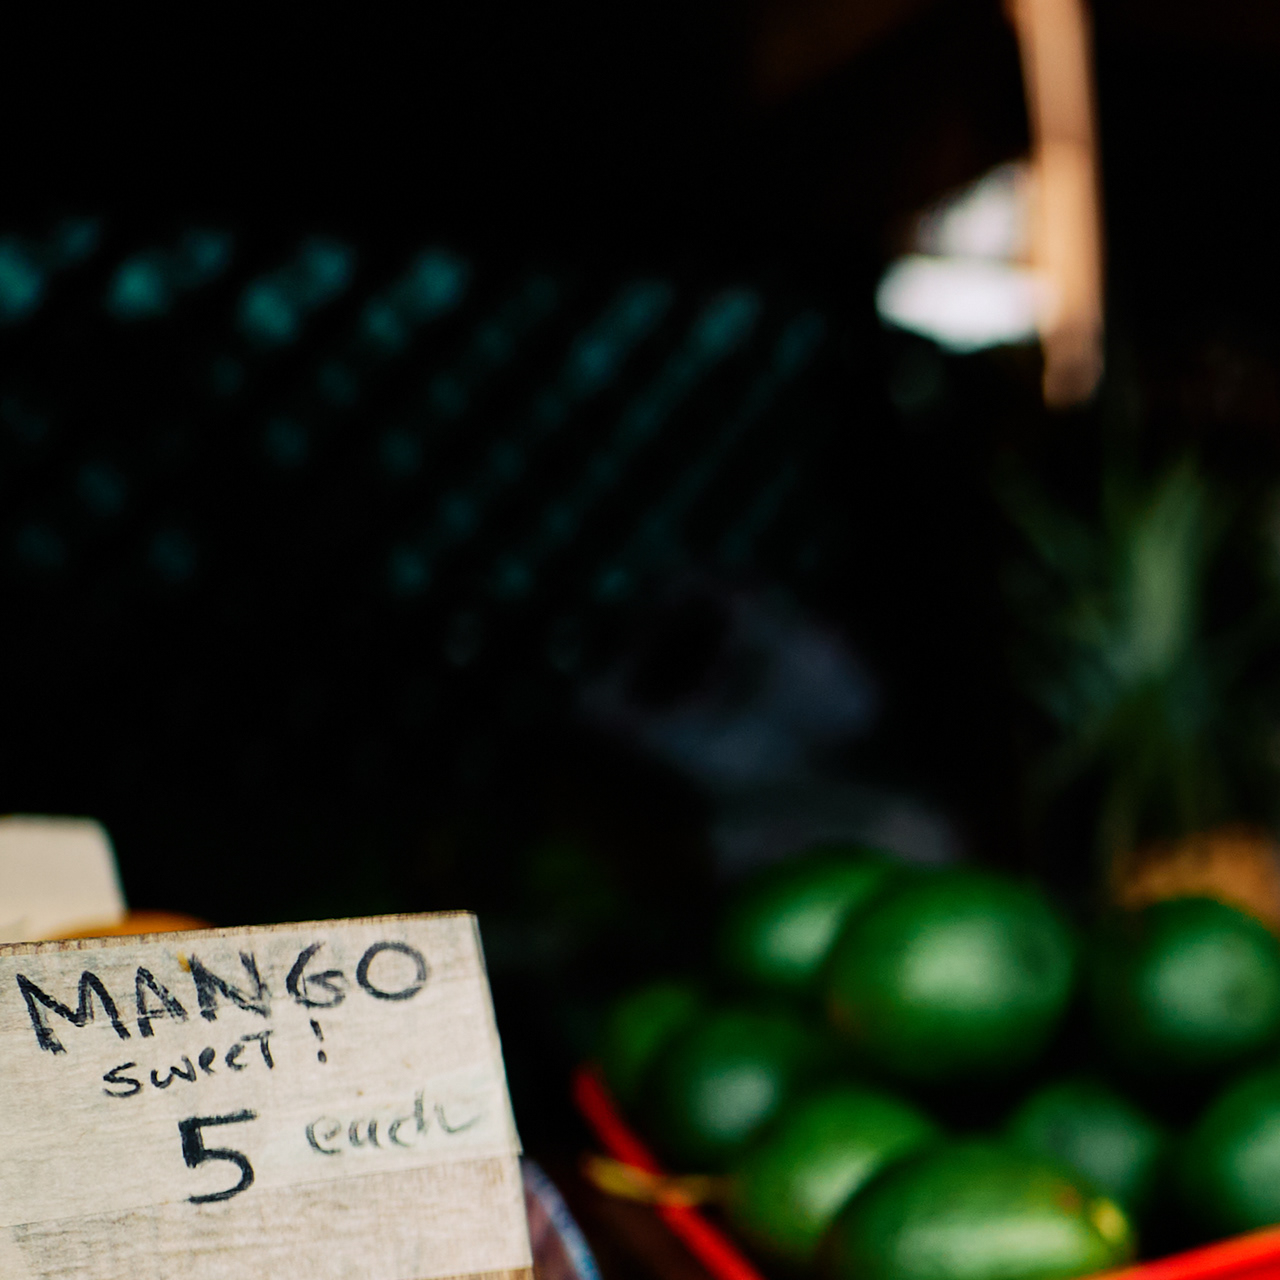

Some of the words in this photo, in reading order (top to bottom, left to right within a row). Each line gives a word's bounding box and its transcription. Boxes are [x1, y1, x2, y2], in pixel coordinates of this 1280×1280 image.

[16, 941, 428, 1056] MANGO
[178, 1109, 260, 1204] 5
[305, 1088, 488, 1155] each
